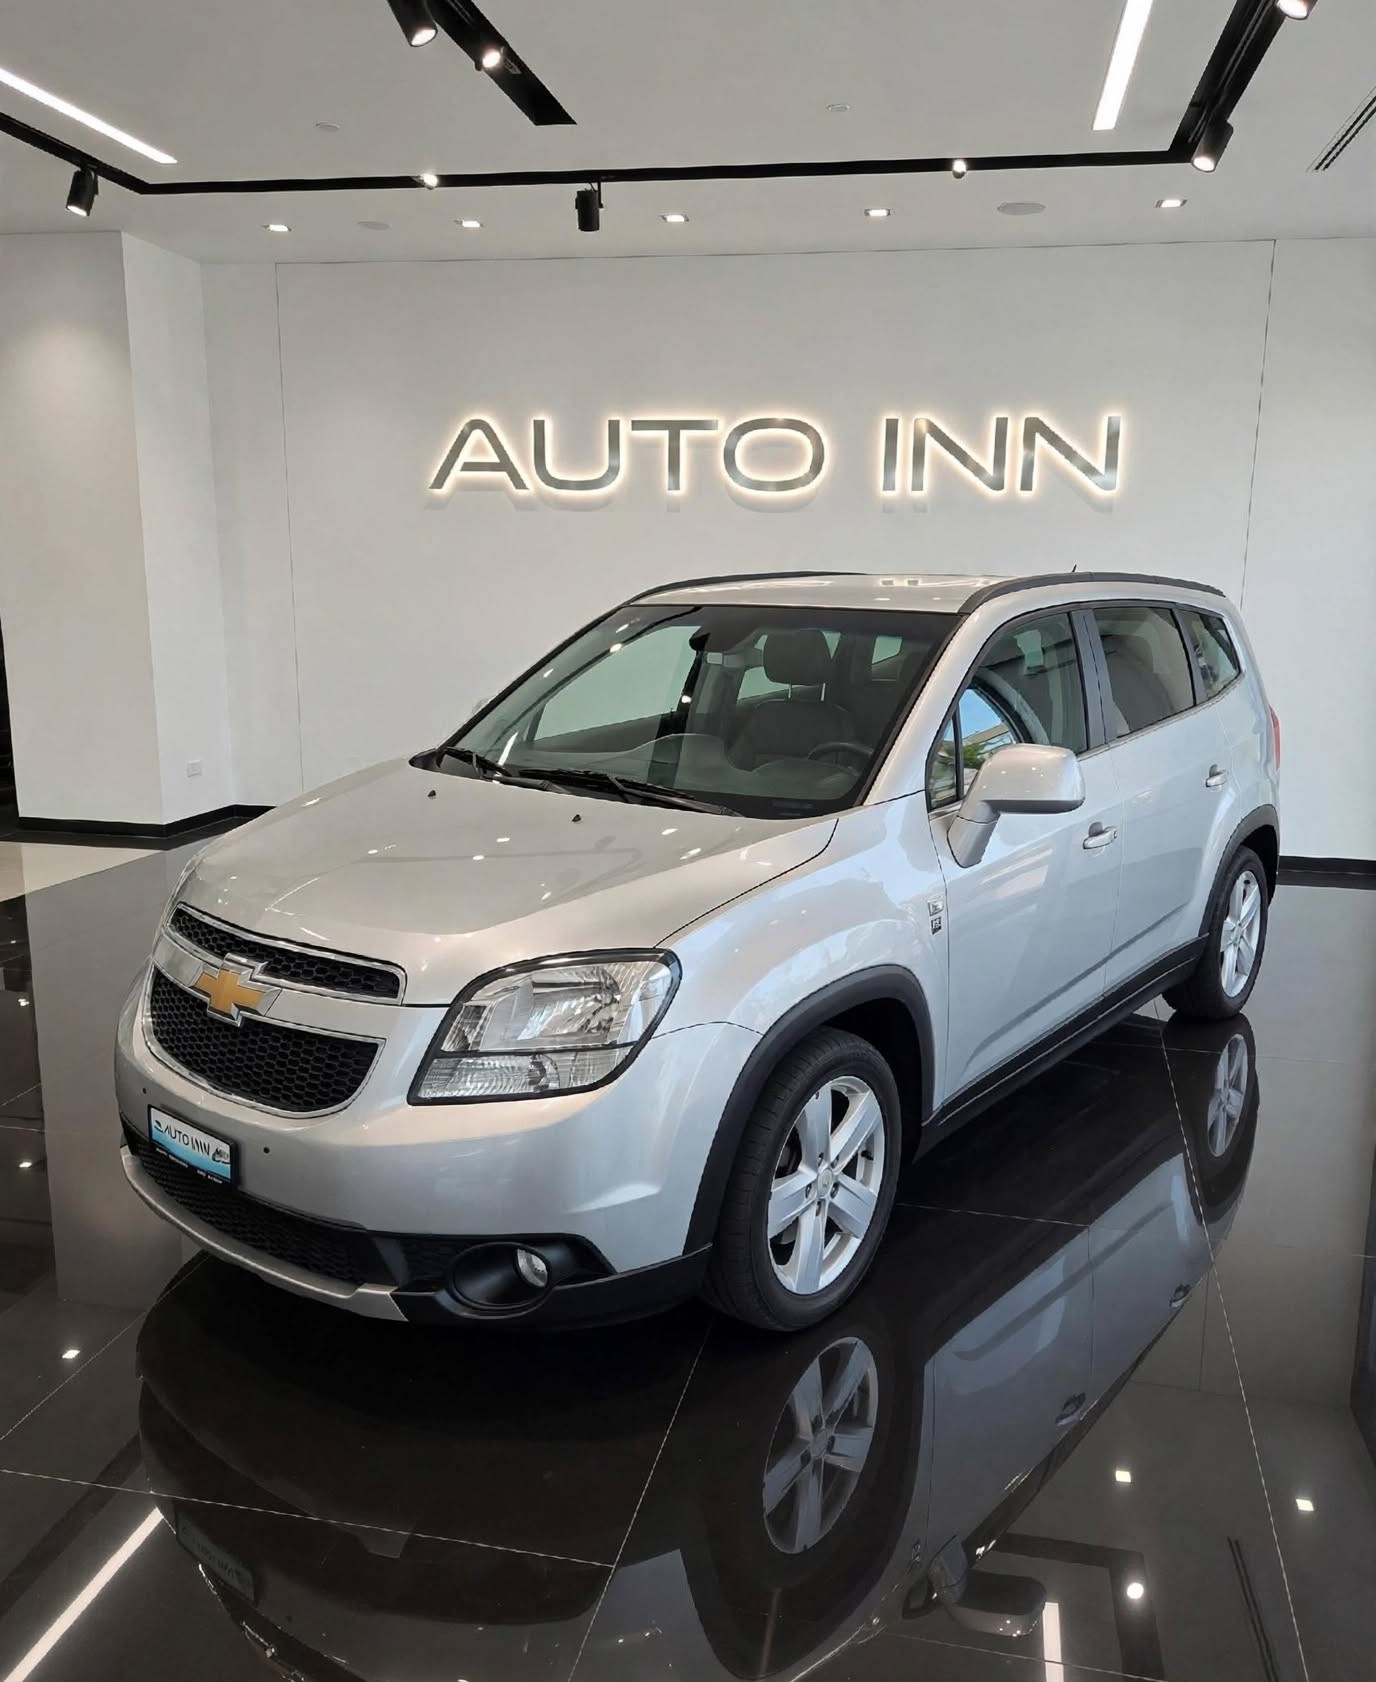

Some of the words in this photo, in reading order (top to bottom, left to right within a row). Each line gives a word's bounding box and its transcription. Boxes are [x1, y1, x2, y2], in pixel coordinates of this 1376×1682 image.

[429, 418, 826, 492] AUTO
[882, 416, 1122, 492] INN
[164, 1125, 190, 1146] AUTO
[191, 1137, 210, 1156] INN
